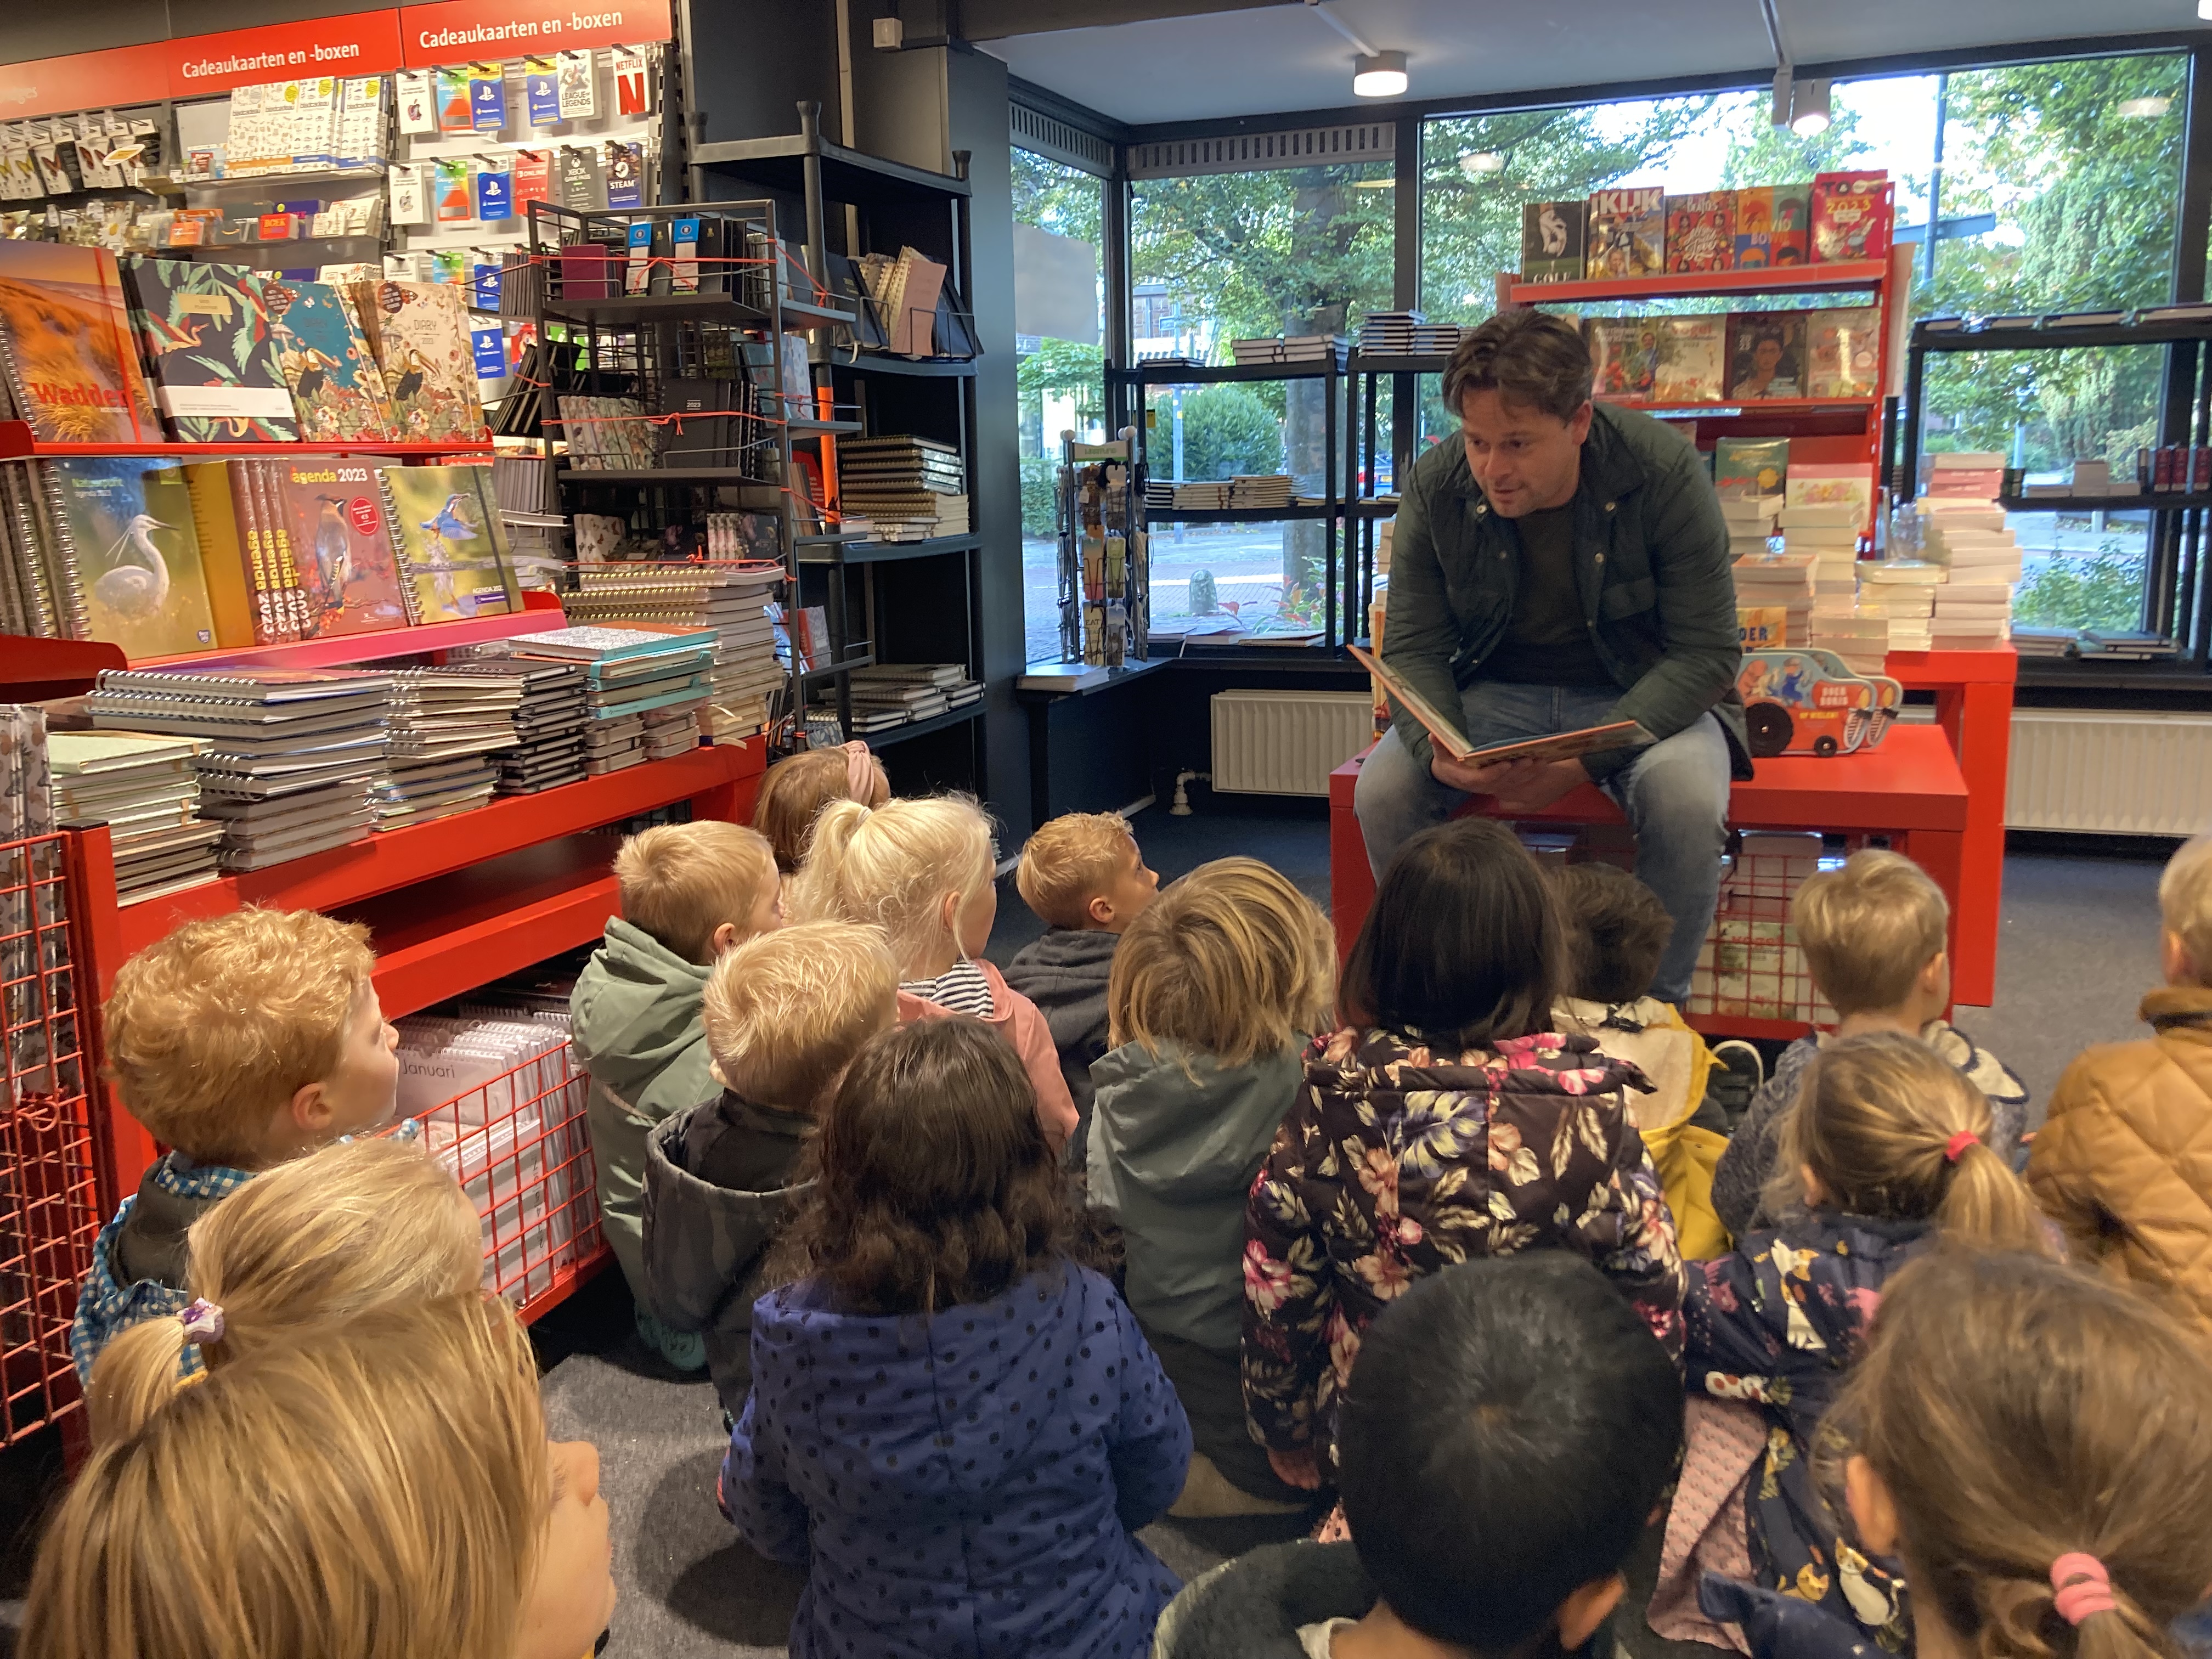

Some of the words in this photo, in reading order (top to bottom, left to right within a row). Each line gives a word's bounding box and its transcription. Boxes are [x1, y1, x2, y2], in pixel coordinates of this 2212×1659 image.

[420, 21, 538, 48] Cadeaukaarten
[542, 19, 562, 34] en
[566, 12, 622, 31] -boxen
[182, 52, 285, 78] Cadeaukaarten
[288, 50, 306, 64] en
[309, 44, 359, 61] -boxen
[616, 58, 643, 71] NETFLIX
[562, 91, 586, 100] LEAGUE
[562, 98, 591, 108] LEGENDS
[524, 169, 546, 177] ONLINE
[567, 167, 586, 176] XBOX
[610, 179, 635, 189] STEAM
[1599, 188, 1663, 215] KIJK
[292, 469, 337, 484] agenda
[337, 468, 368, 482] 2023
[403, 1059, 455, 1079] Januari
